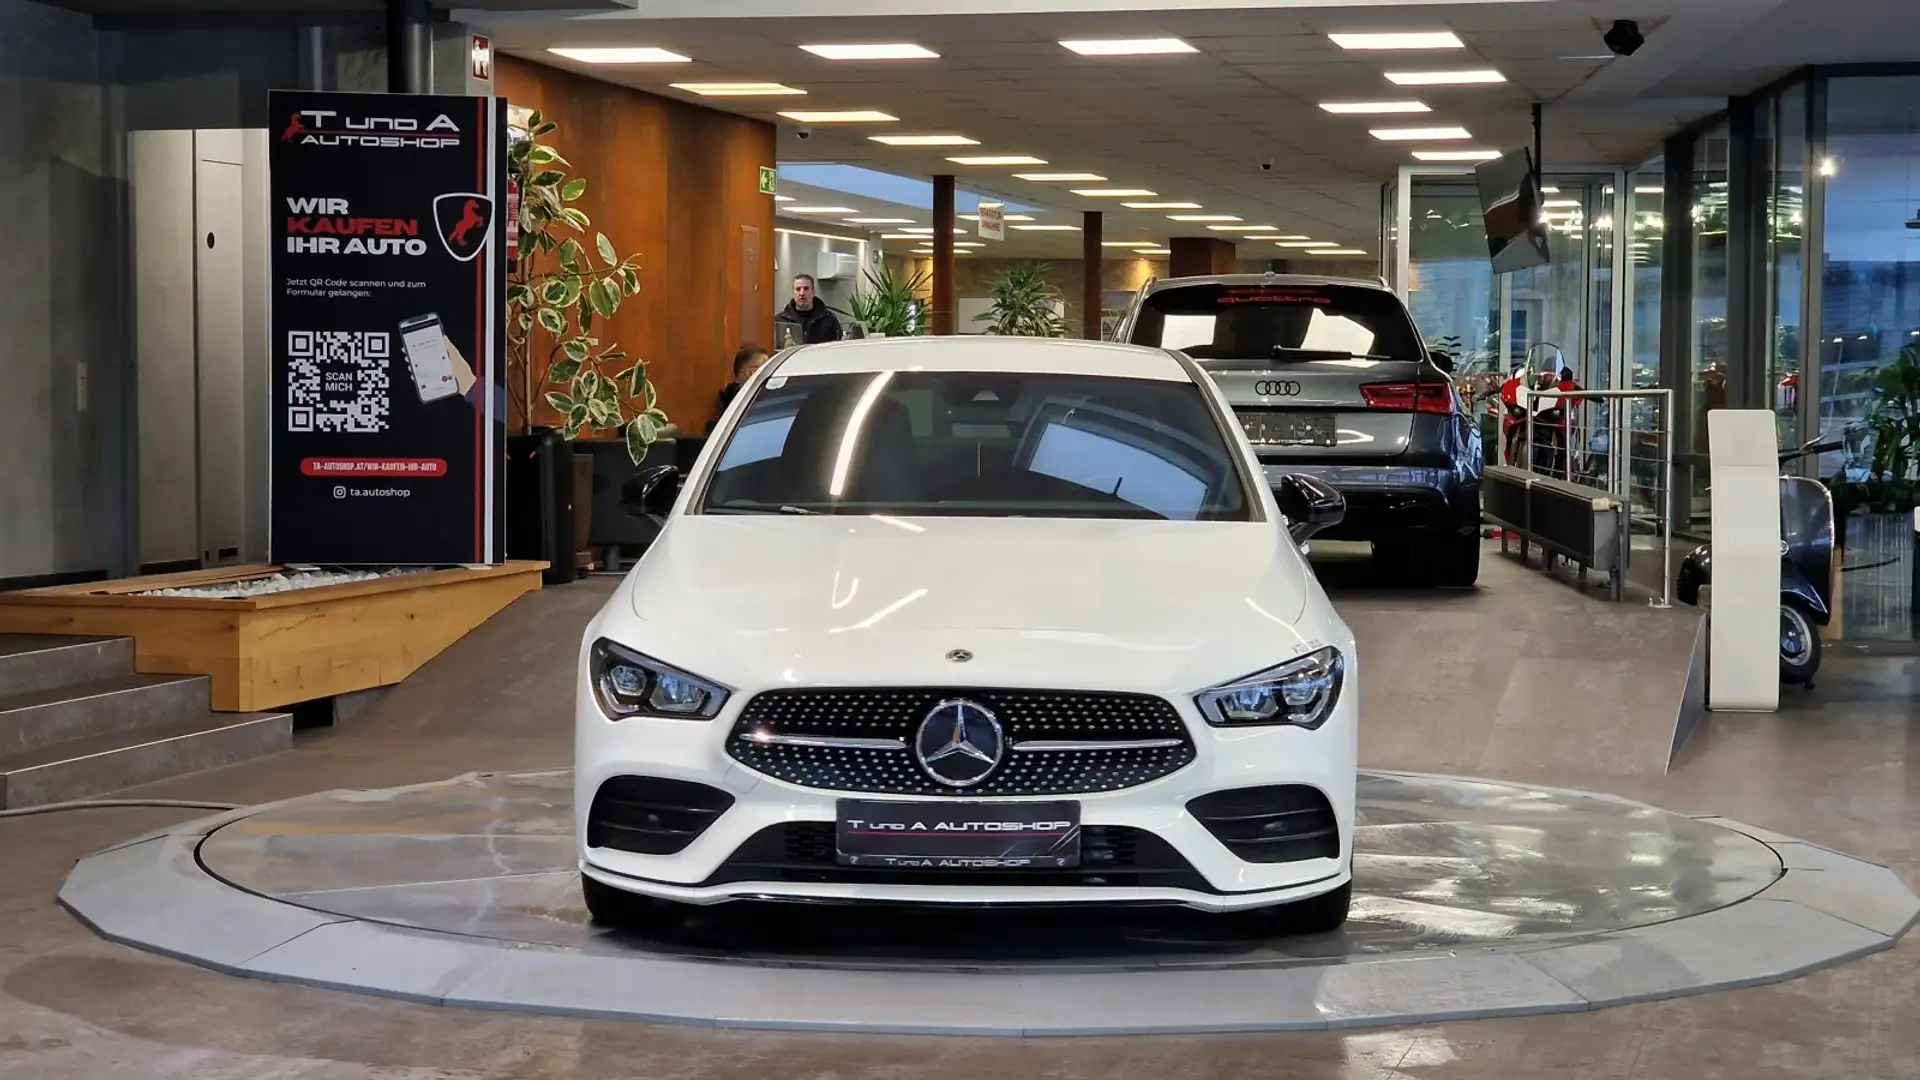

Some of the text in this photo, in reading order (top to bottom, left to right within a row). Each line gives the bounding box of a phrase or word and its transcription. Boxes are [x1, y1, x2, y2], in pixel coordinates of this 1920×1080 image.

[300, 110, 337, 128] T
[425, 114, 461, 132] A
[300, 135, 461, 148] AUTOSHOP
[286, 196, 349, 215] WIR
[286, 216, 418, 236] KAUFEN
[286, 237, 427, 256] IHR AUTO
[286, 278, 427, 289] Jetzt QR Code scannen und zum
[286, 288, 371, 299] Formular gelangen:
[1216, 295, 1331, 304] quattro
[325, 372, 353, 382] SCAN
[325, 382, 353, 392] MICH
[350, 487, 412, 498] ta.autoshop
[847, 819, 865, 829] T
[910, 821, 928, 831] A
[933, 821, 1072, 831] AUTOSHOP
[885, 858, 898, 866] T
[920, 858, 933, 867] A
[939, 859, 1032, 867] AUTOSHOP
